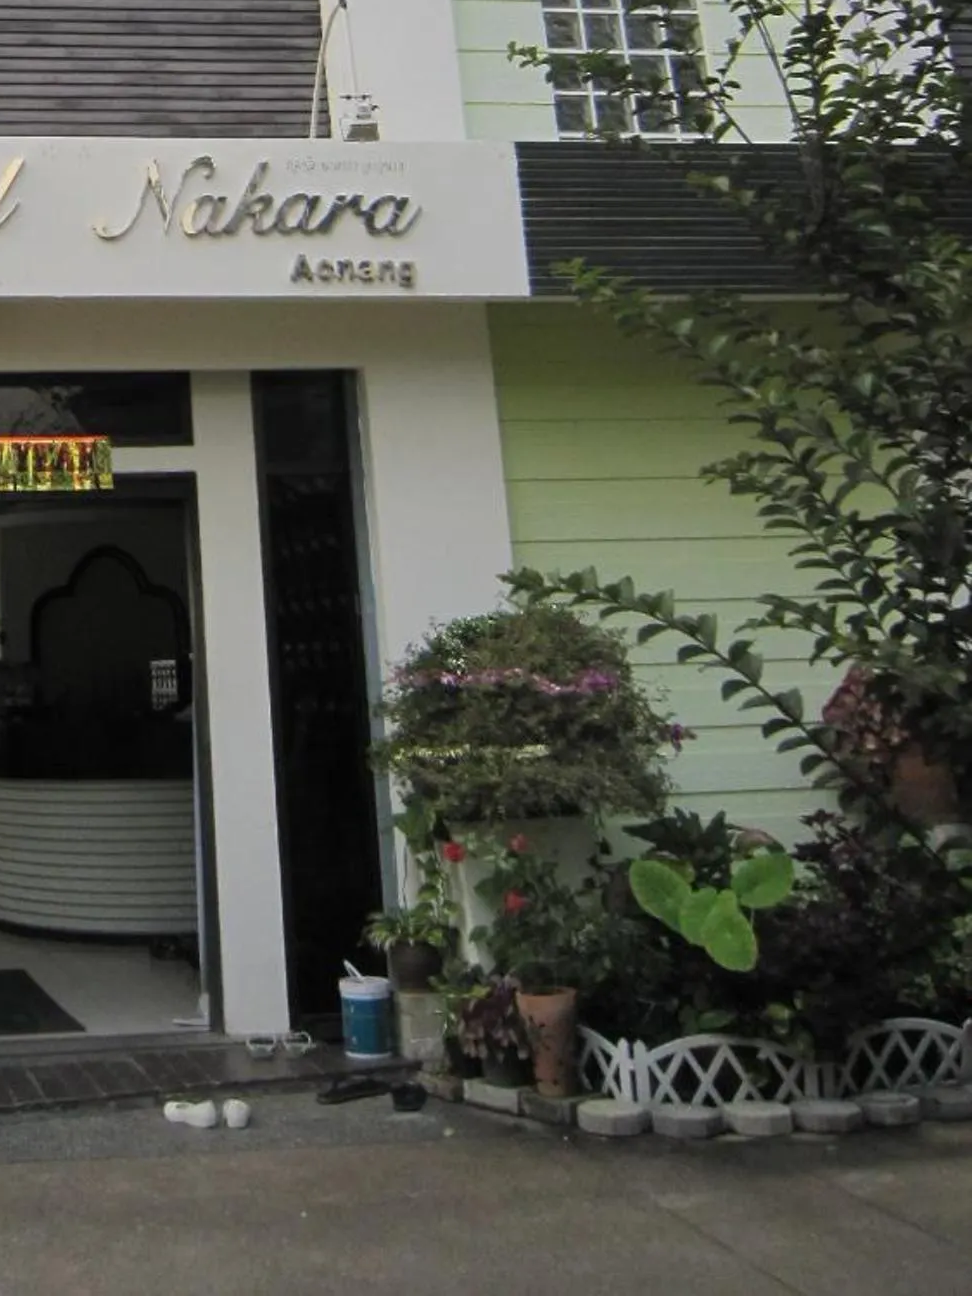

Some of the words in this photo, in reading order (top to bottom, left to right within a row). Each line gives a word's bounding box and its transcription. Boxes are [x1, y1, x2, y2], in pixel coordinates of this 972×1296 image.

[91, 155, 423, 241] Nakara
[290, 253, 417, 289] Aonang
[12, 442, 94, 473] YEAR
